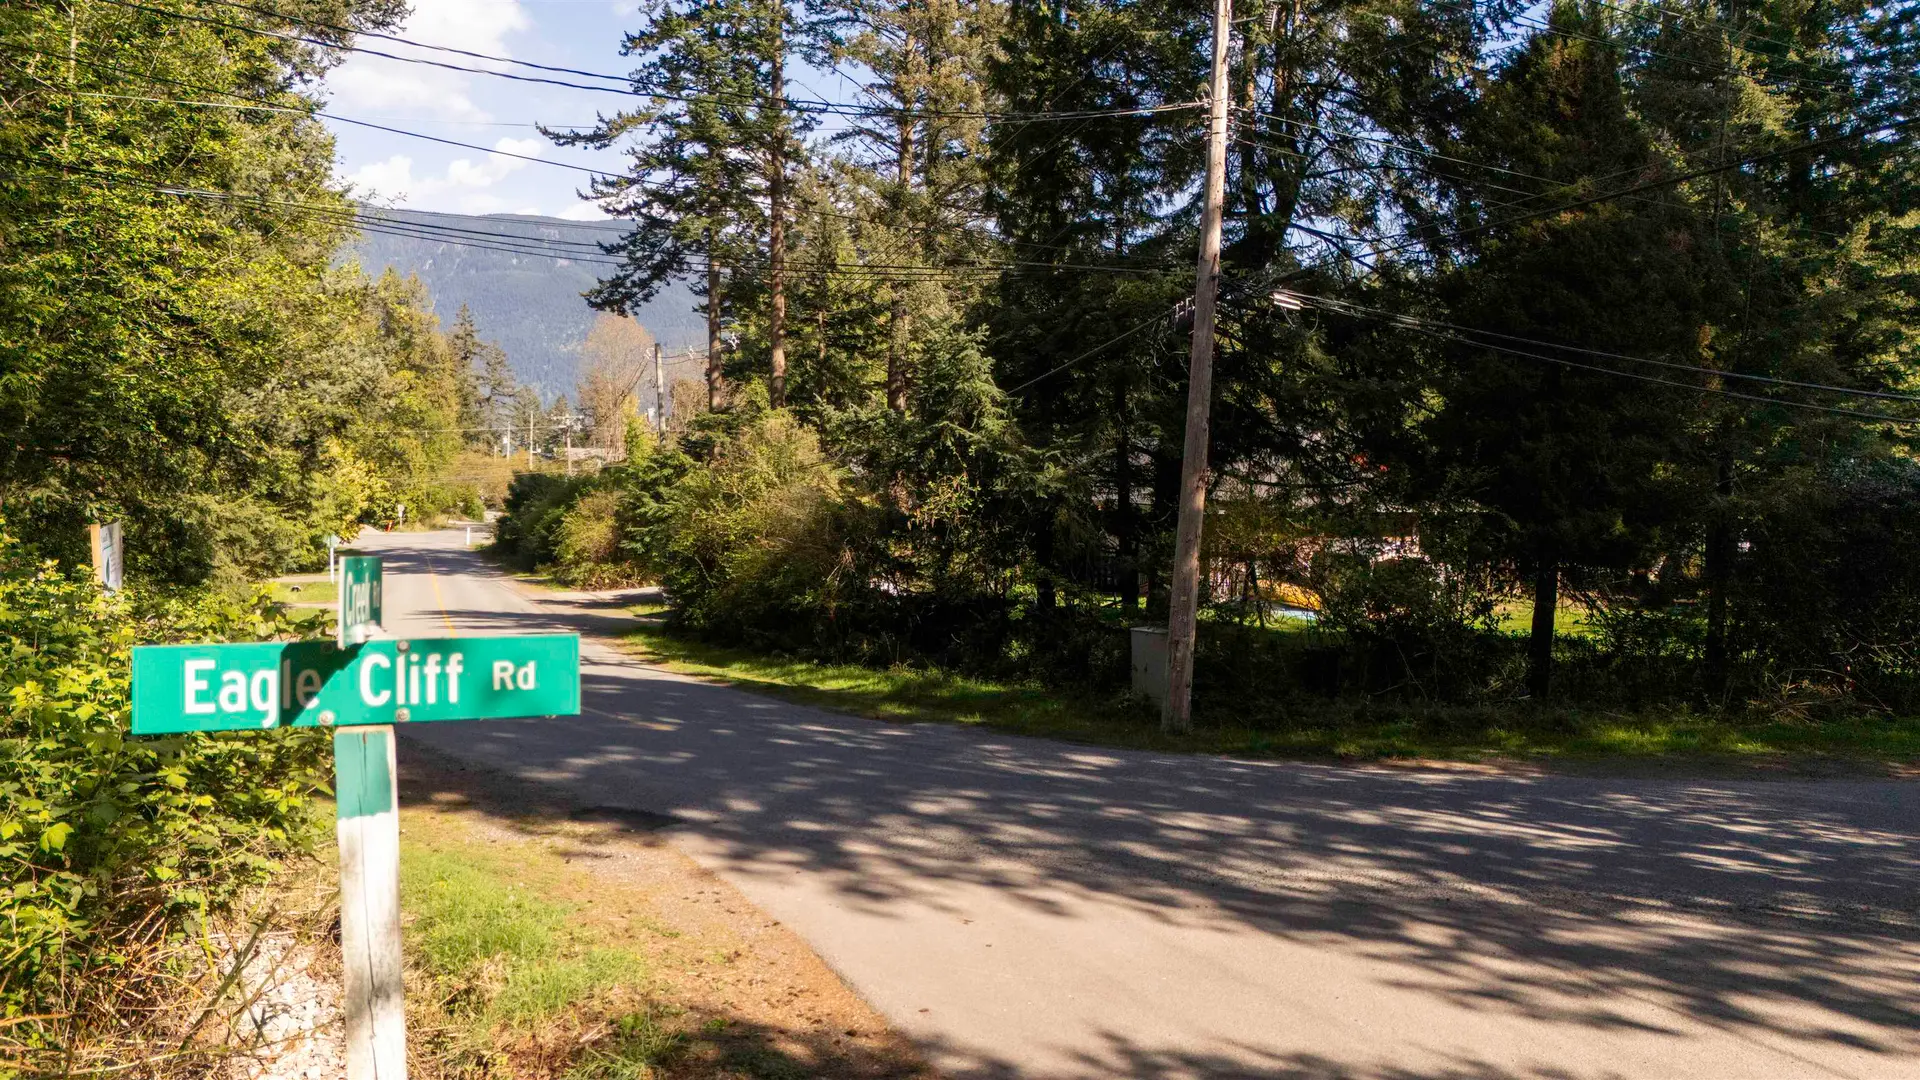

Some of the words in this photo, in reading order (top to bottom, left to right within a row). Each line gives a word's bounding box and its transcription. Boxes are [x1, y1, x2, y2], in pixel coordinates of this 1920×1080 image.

[184, 659, 322, 728] Eagle
[359, 653, 464, 707] Cliff
[492, 660, 536, 691] Rd
